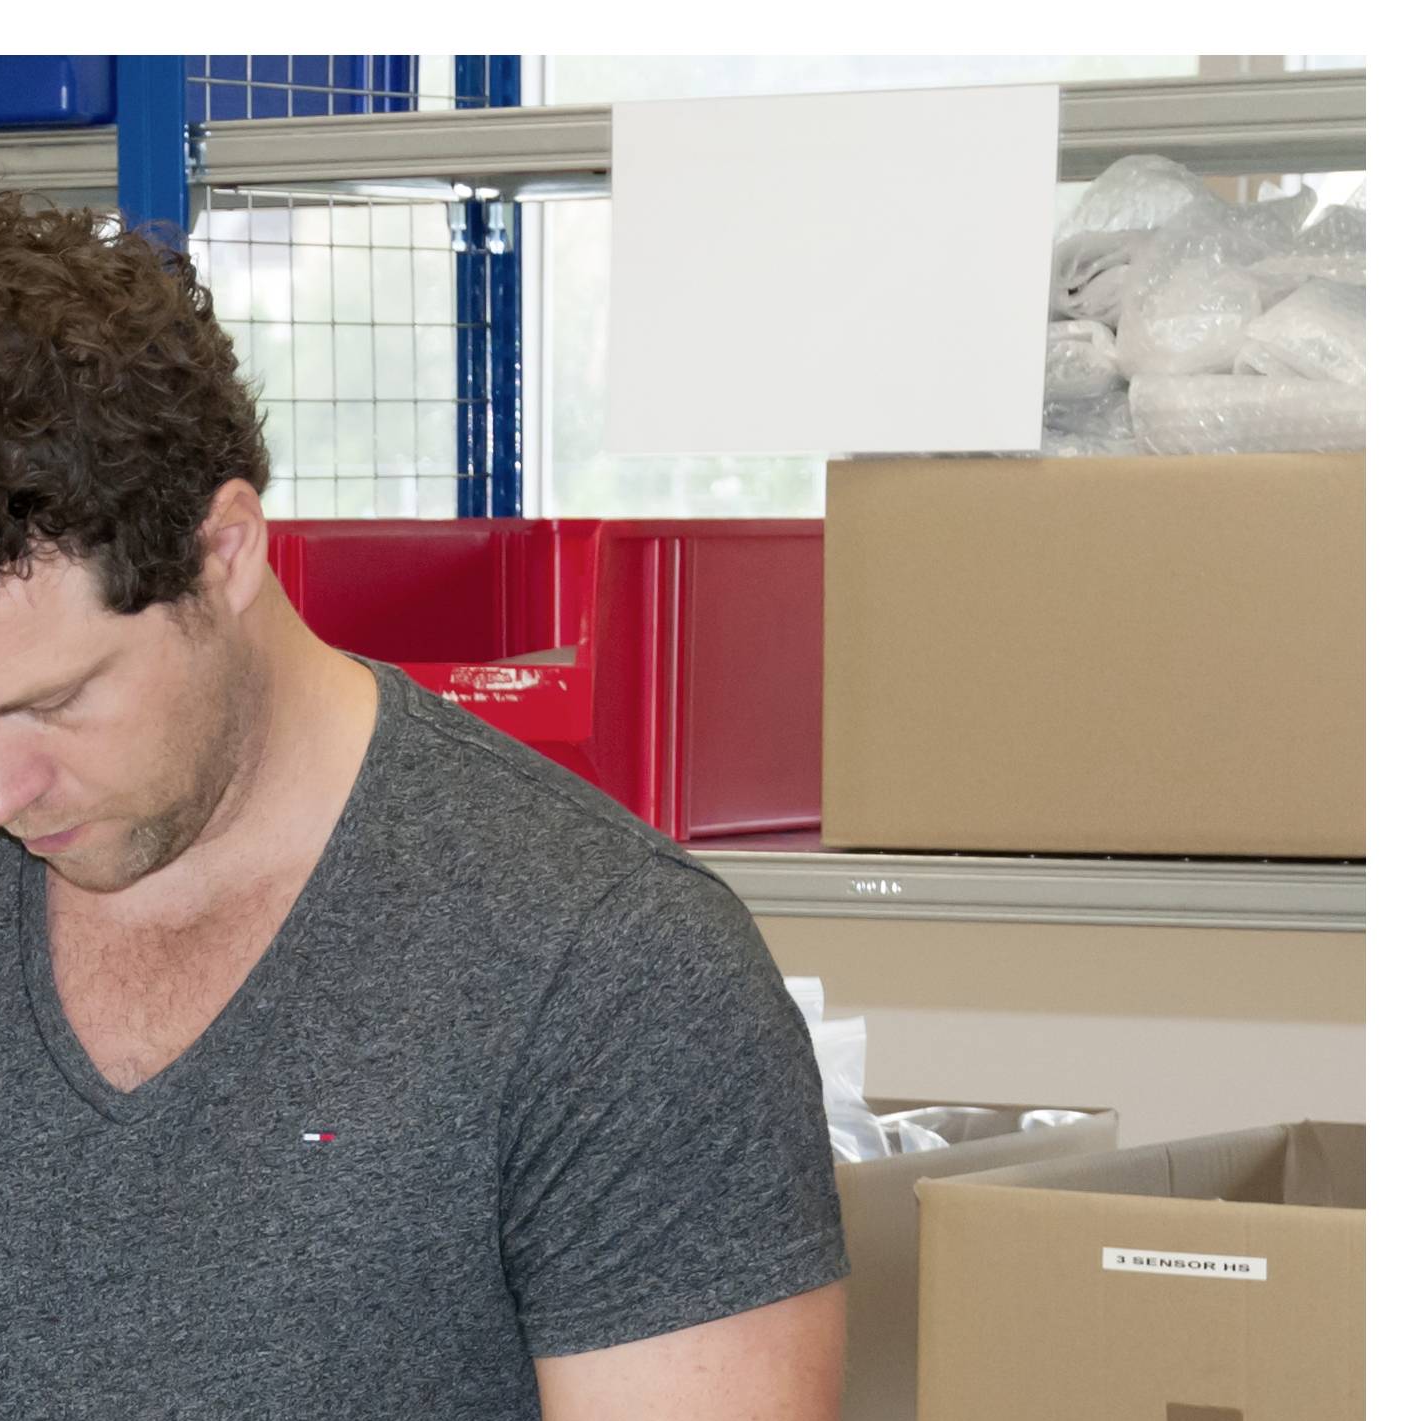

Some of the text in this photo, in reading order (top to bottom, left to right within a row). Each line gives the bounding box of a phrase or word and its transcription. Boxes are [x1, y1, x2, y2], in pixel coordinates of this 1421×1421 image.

[1115, 1255, 1251, 1273] 3 SENSOR HS
